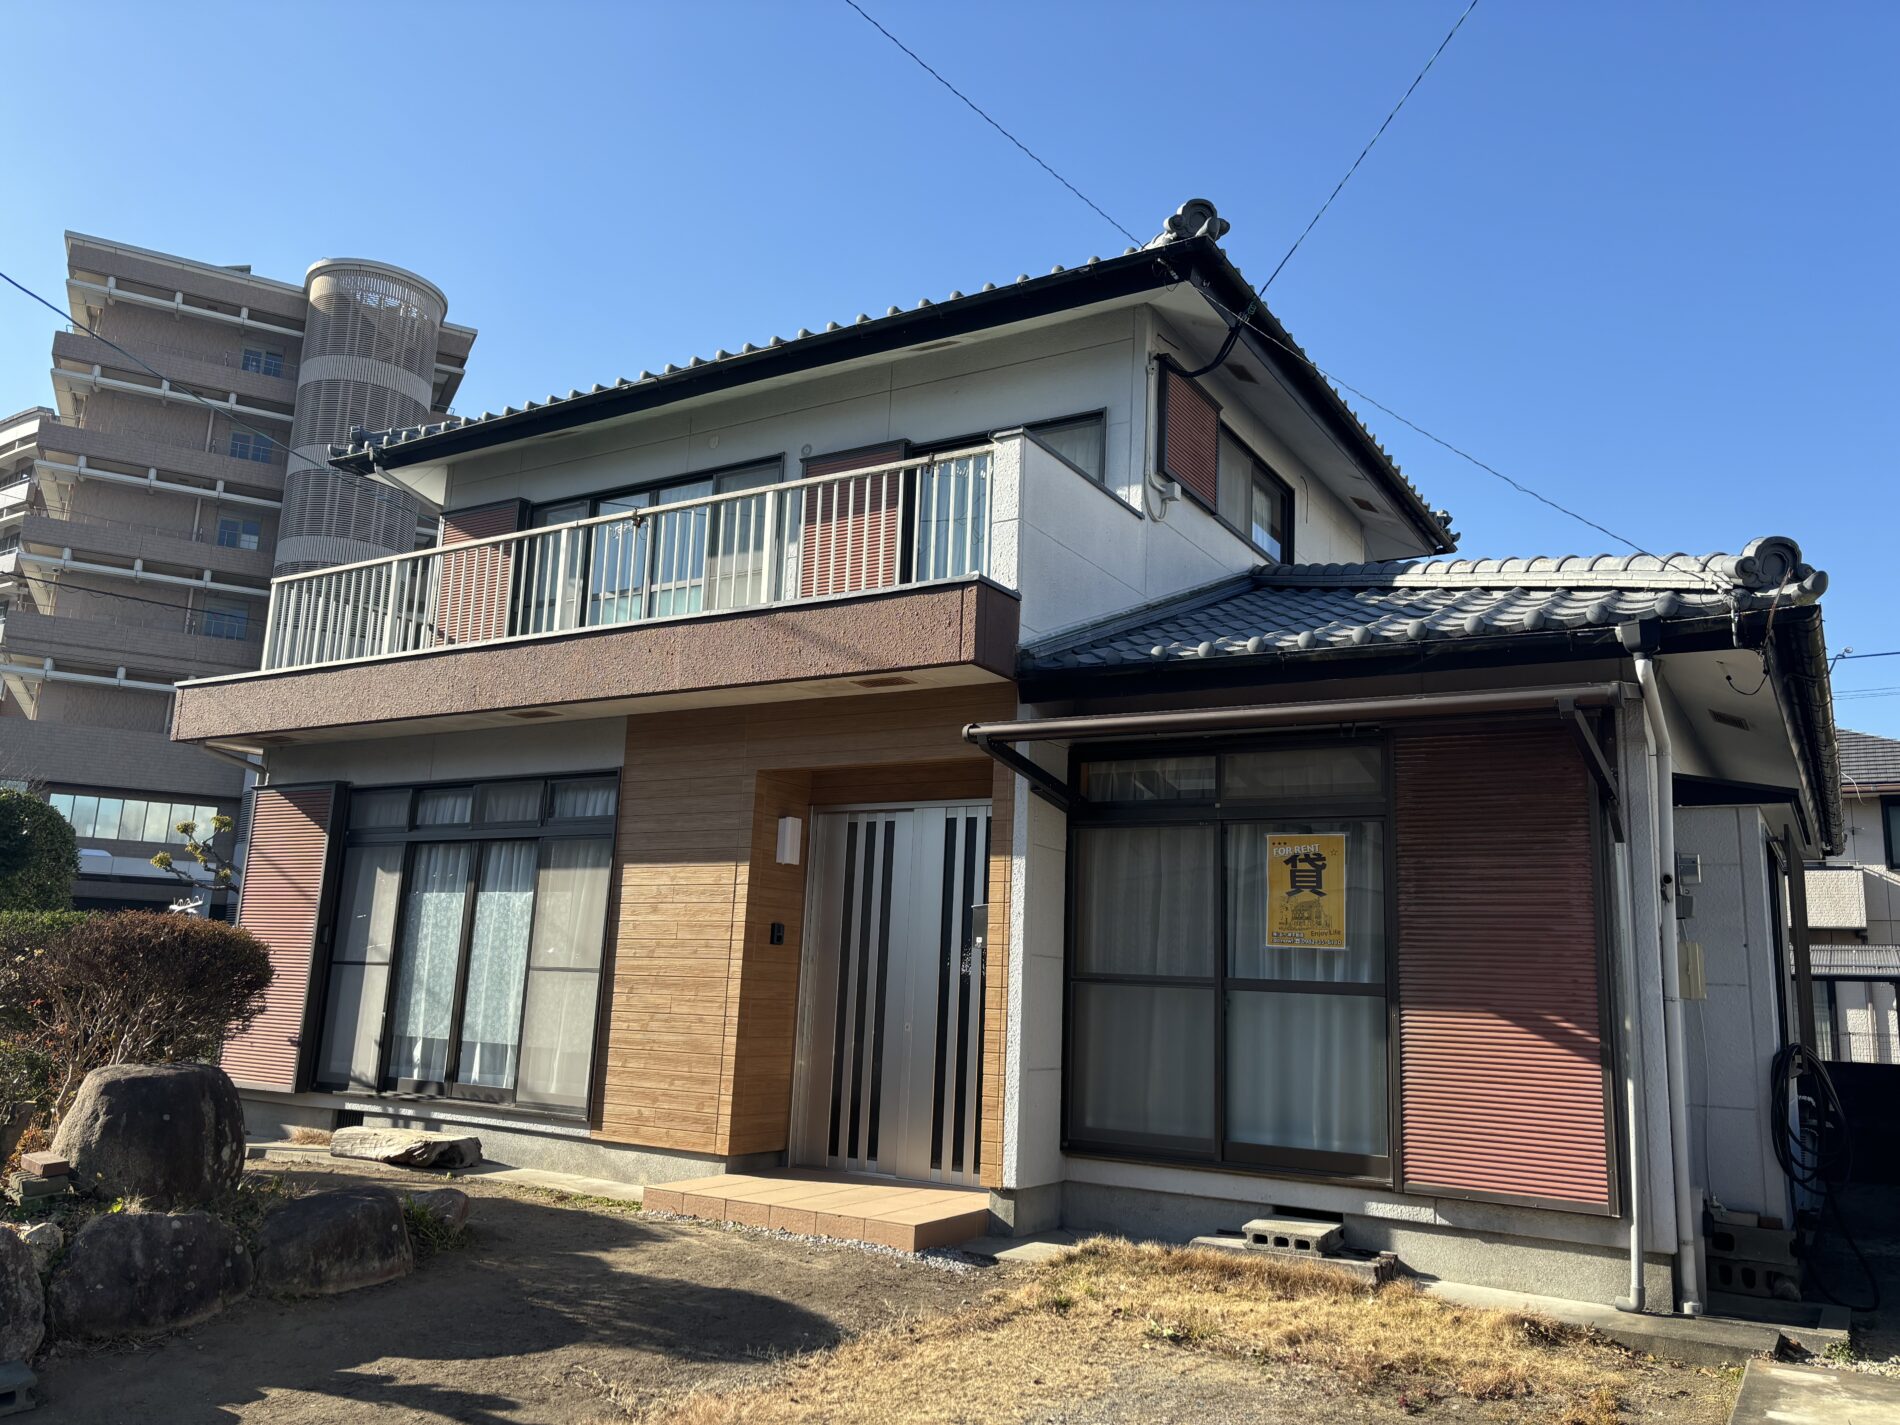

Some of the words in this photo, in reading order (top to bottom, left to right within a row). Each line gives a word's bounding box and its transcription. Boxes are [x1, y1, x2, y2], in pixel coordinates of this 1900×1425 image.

[1273, 847, 1292, 857] FOR
[1294, 843, 1320, 854] RENT
[1283, 853, 1327, 897] 貸
